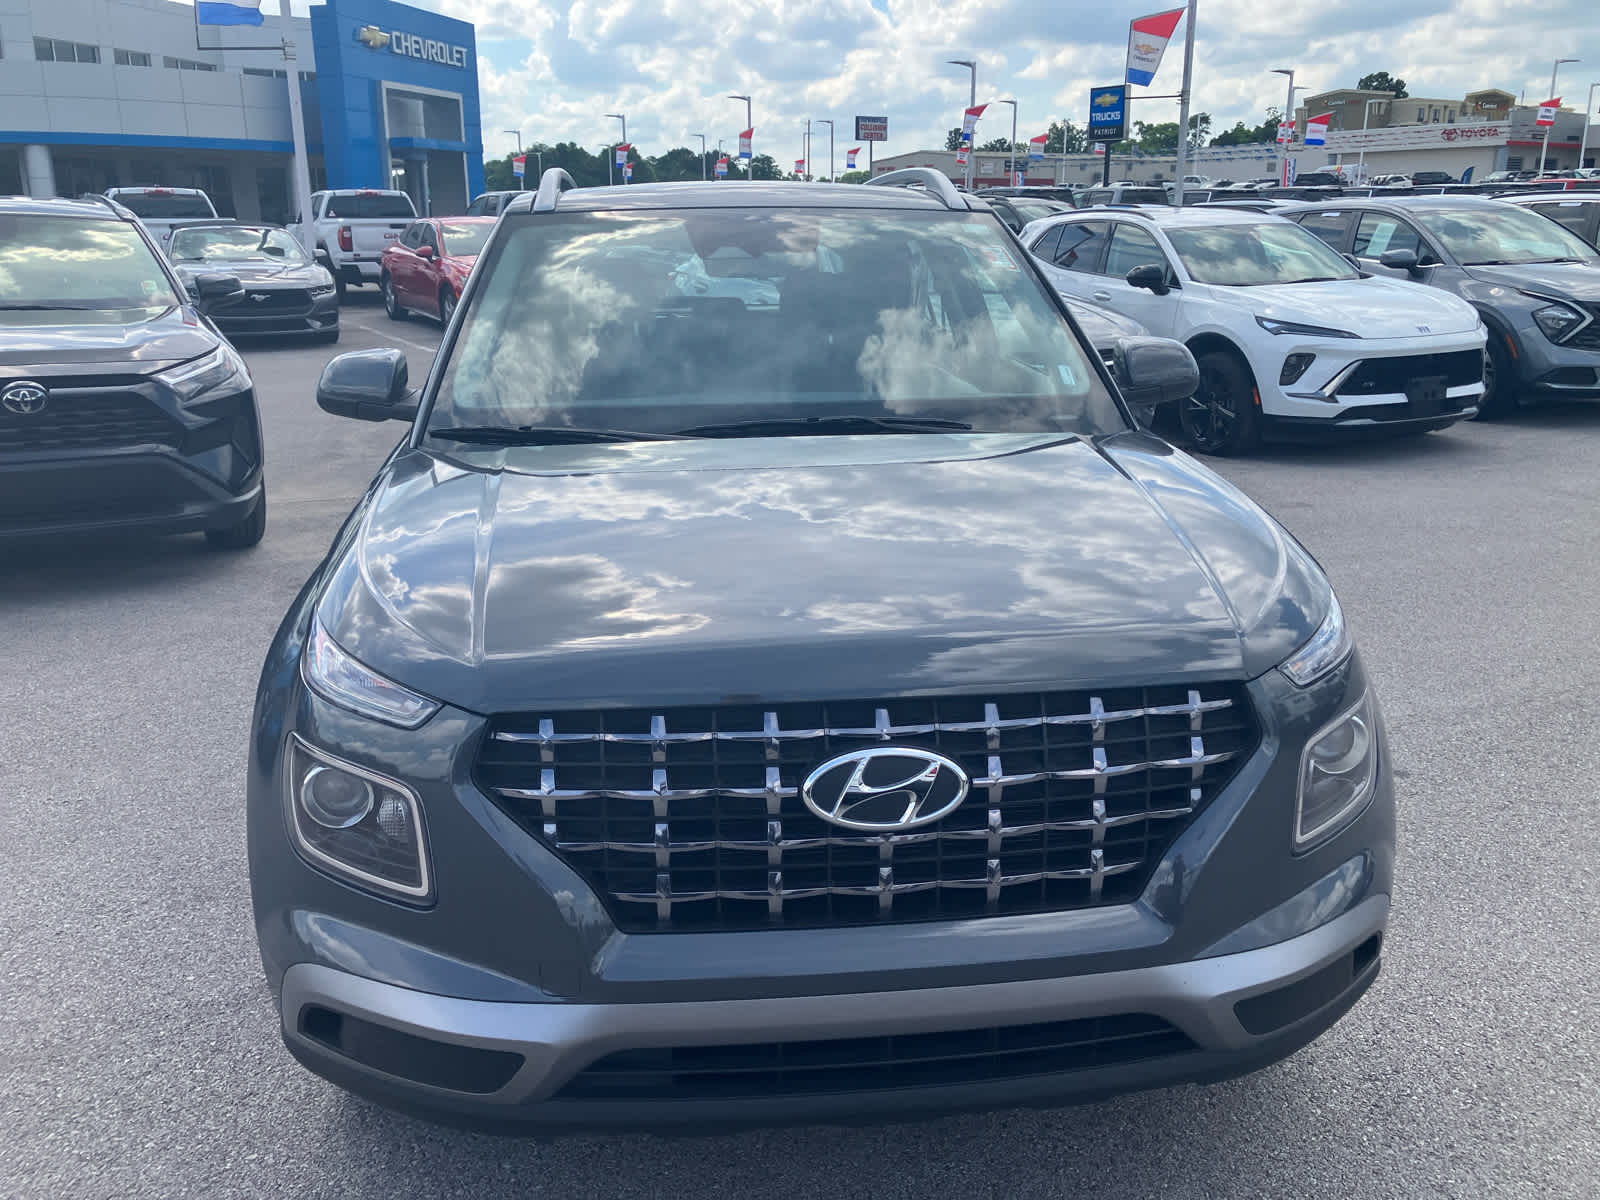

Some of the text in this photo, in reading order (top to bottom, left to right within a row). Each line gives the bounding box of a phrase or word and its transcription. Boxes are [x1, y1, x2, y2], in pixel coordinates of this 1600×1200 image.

[392, 31, 467, 68] CHEVROLET
[1092, 111, 1120, 121] TRUCKS
[1459, 128, 1499, 137] TOYOTA
